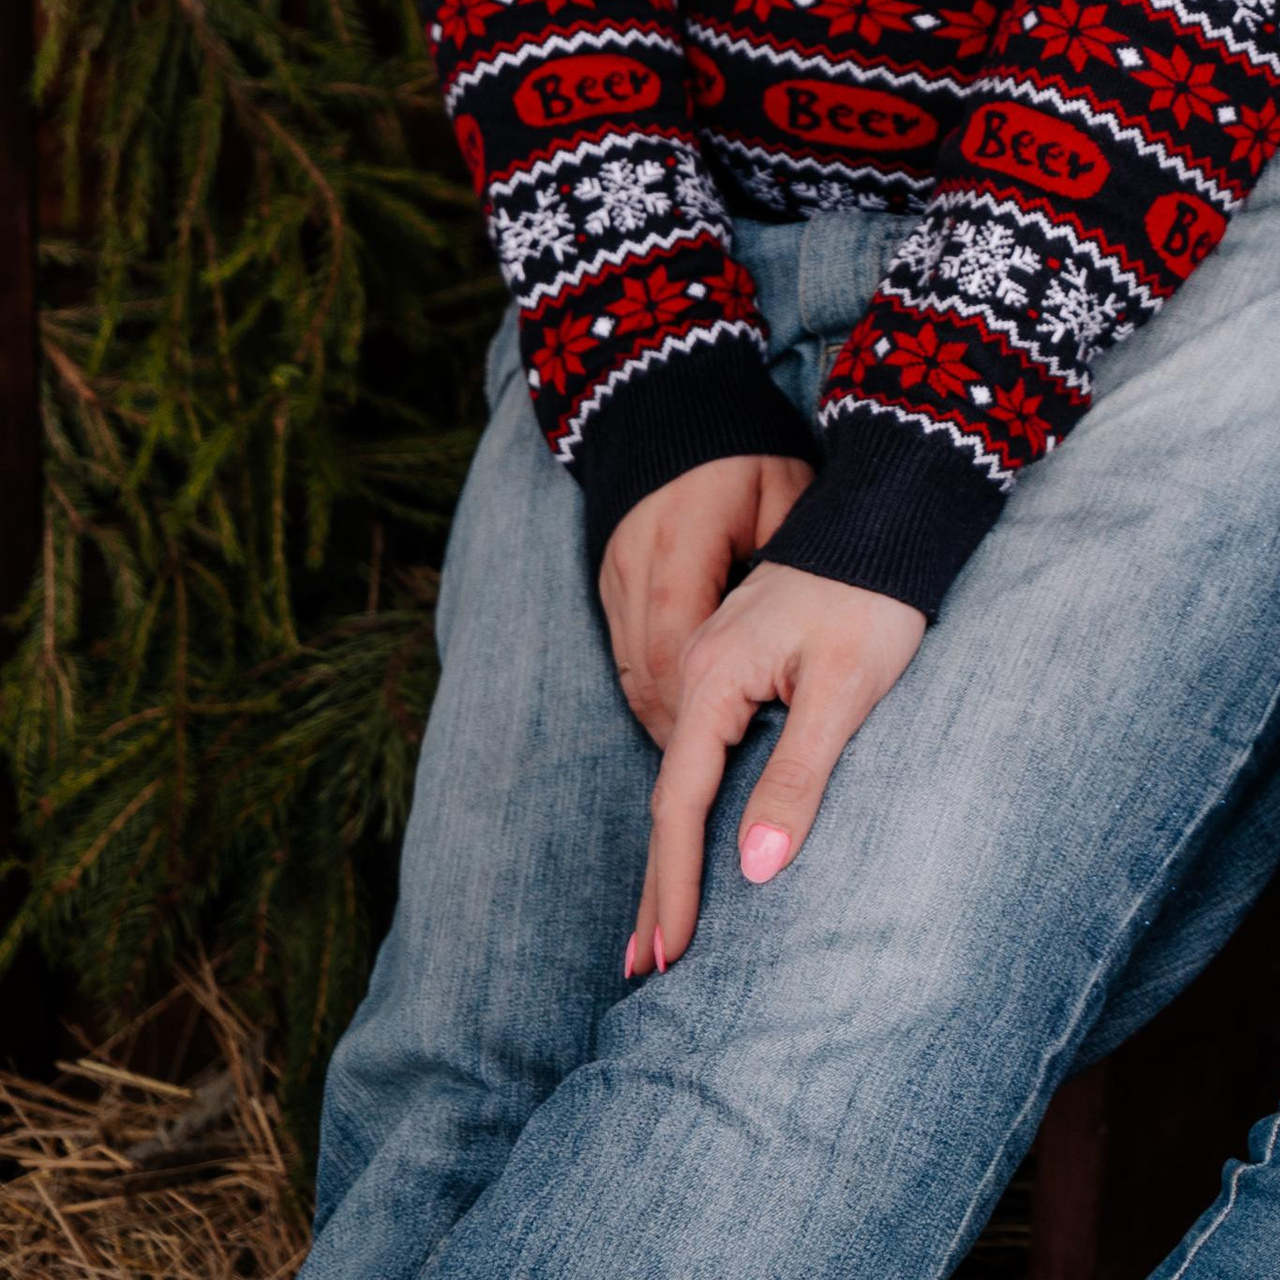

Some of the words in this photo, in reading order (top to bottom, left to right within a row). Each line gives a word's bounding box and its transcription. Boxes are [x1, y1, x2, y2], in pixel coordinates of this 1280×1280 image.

[532, 70, 650, 120] Beer
[786, 87, 920, 138] Beer
[975, 109, 1096, 180] Beer
[1162, 201, 1213, 264] Be
